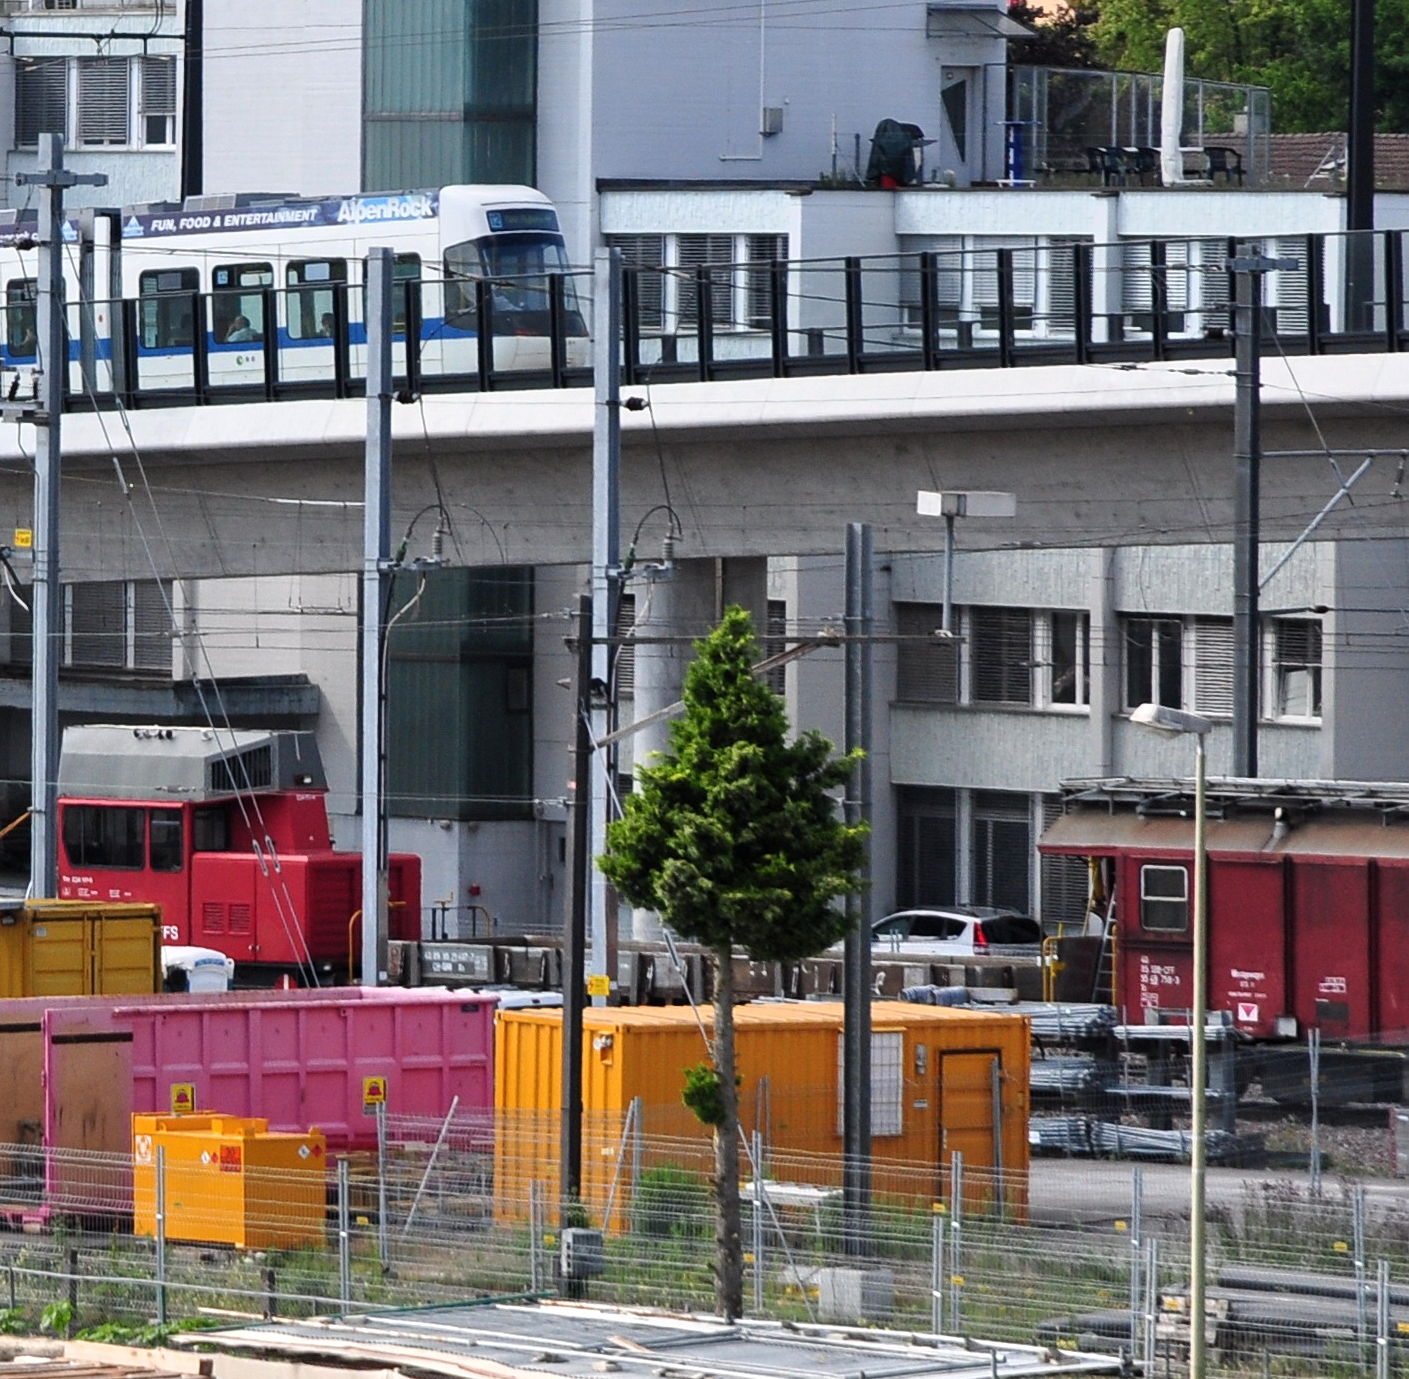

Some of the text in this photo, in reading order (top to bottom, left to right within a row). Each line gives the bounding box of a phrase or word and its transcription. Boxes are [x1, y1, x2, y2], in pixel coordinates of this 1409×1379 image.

[151, 219, 177, 232] FUN,
[179, 216, 211, 230] FOOD
[213, 215, 220, 227] &
[224, 209, 318, 227] ENTERTAINMENT
[337, 197, 433, 224] AlpenRock
